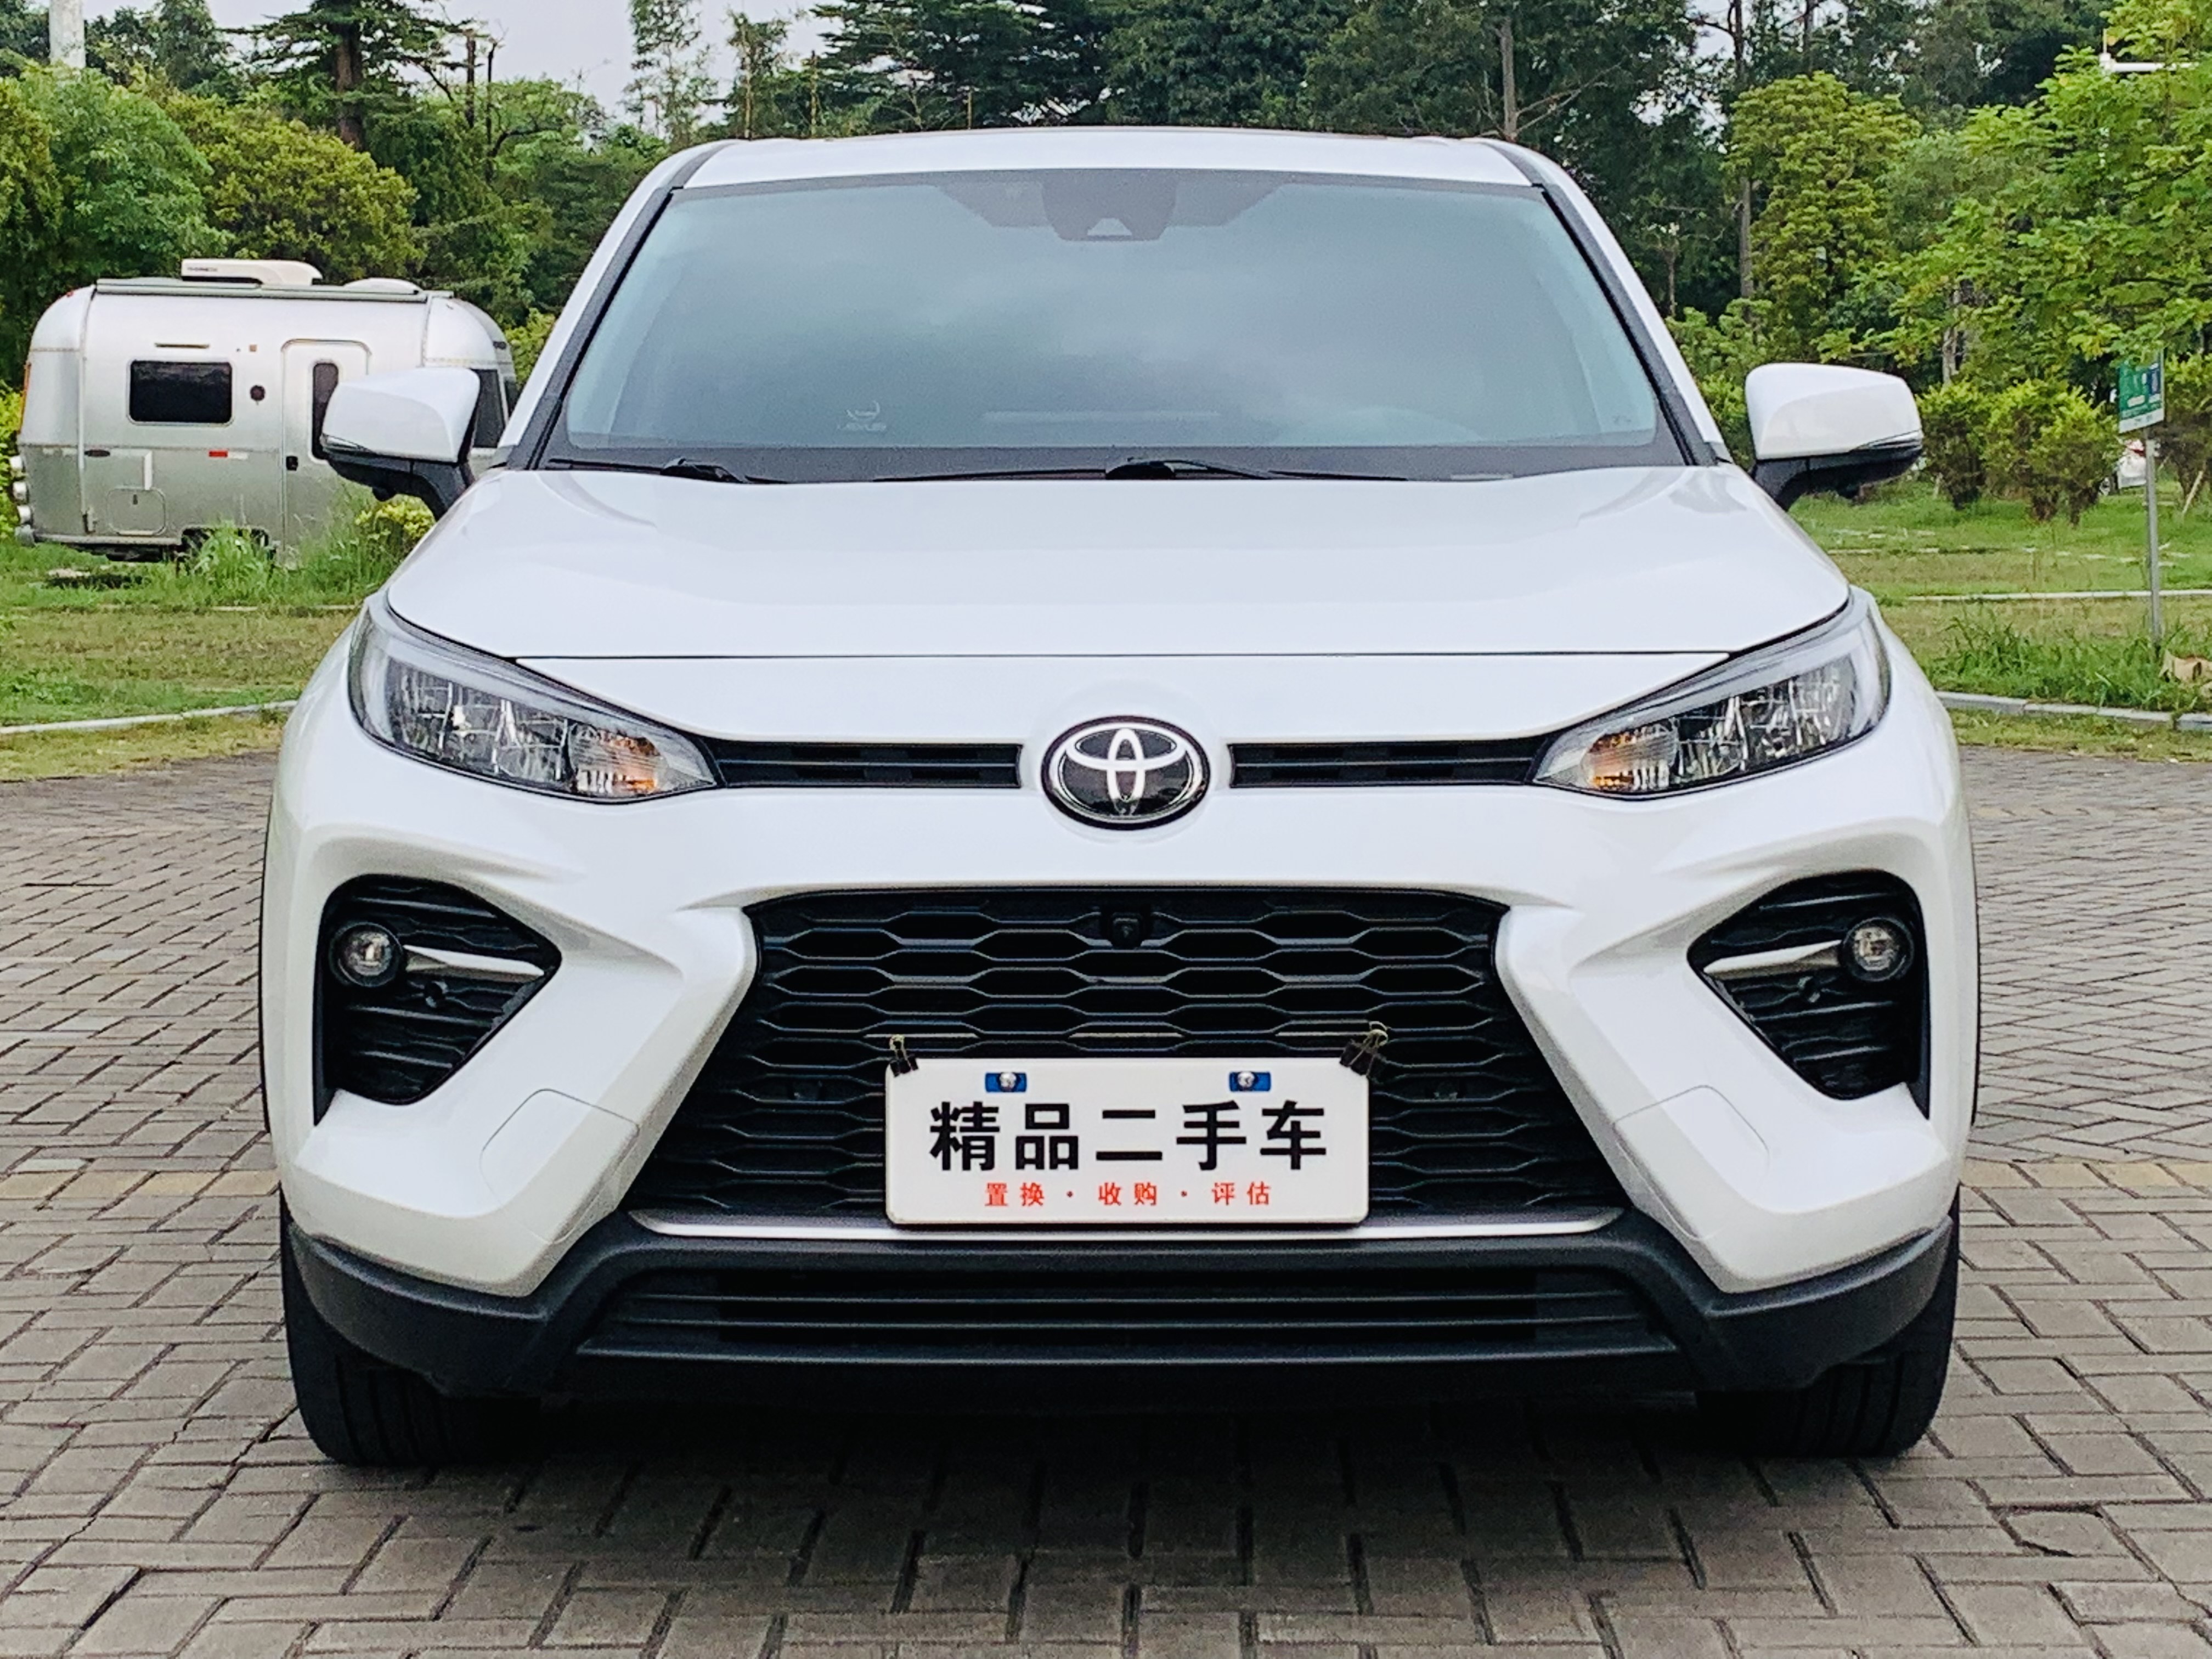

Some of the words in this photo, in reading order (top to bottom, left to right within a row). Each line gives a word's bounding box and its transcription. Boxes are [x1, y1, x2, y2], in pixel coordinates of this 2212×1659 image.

[929, 1099, 1327, 1171] 精品二手车
